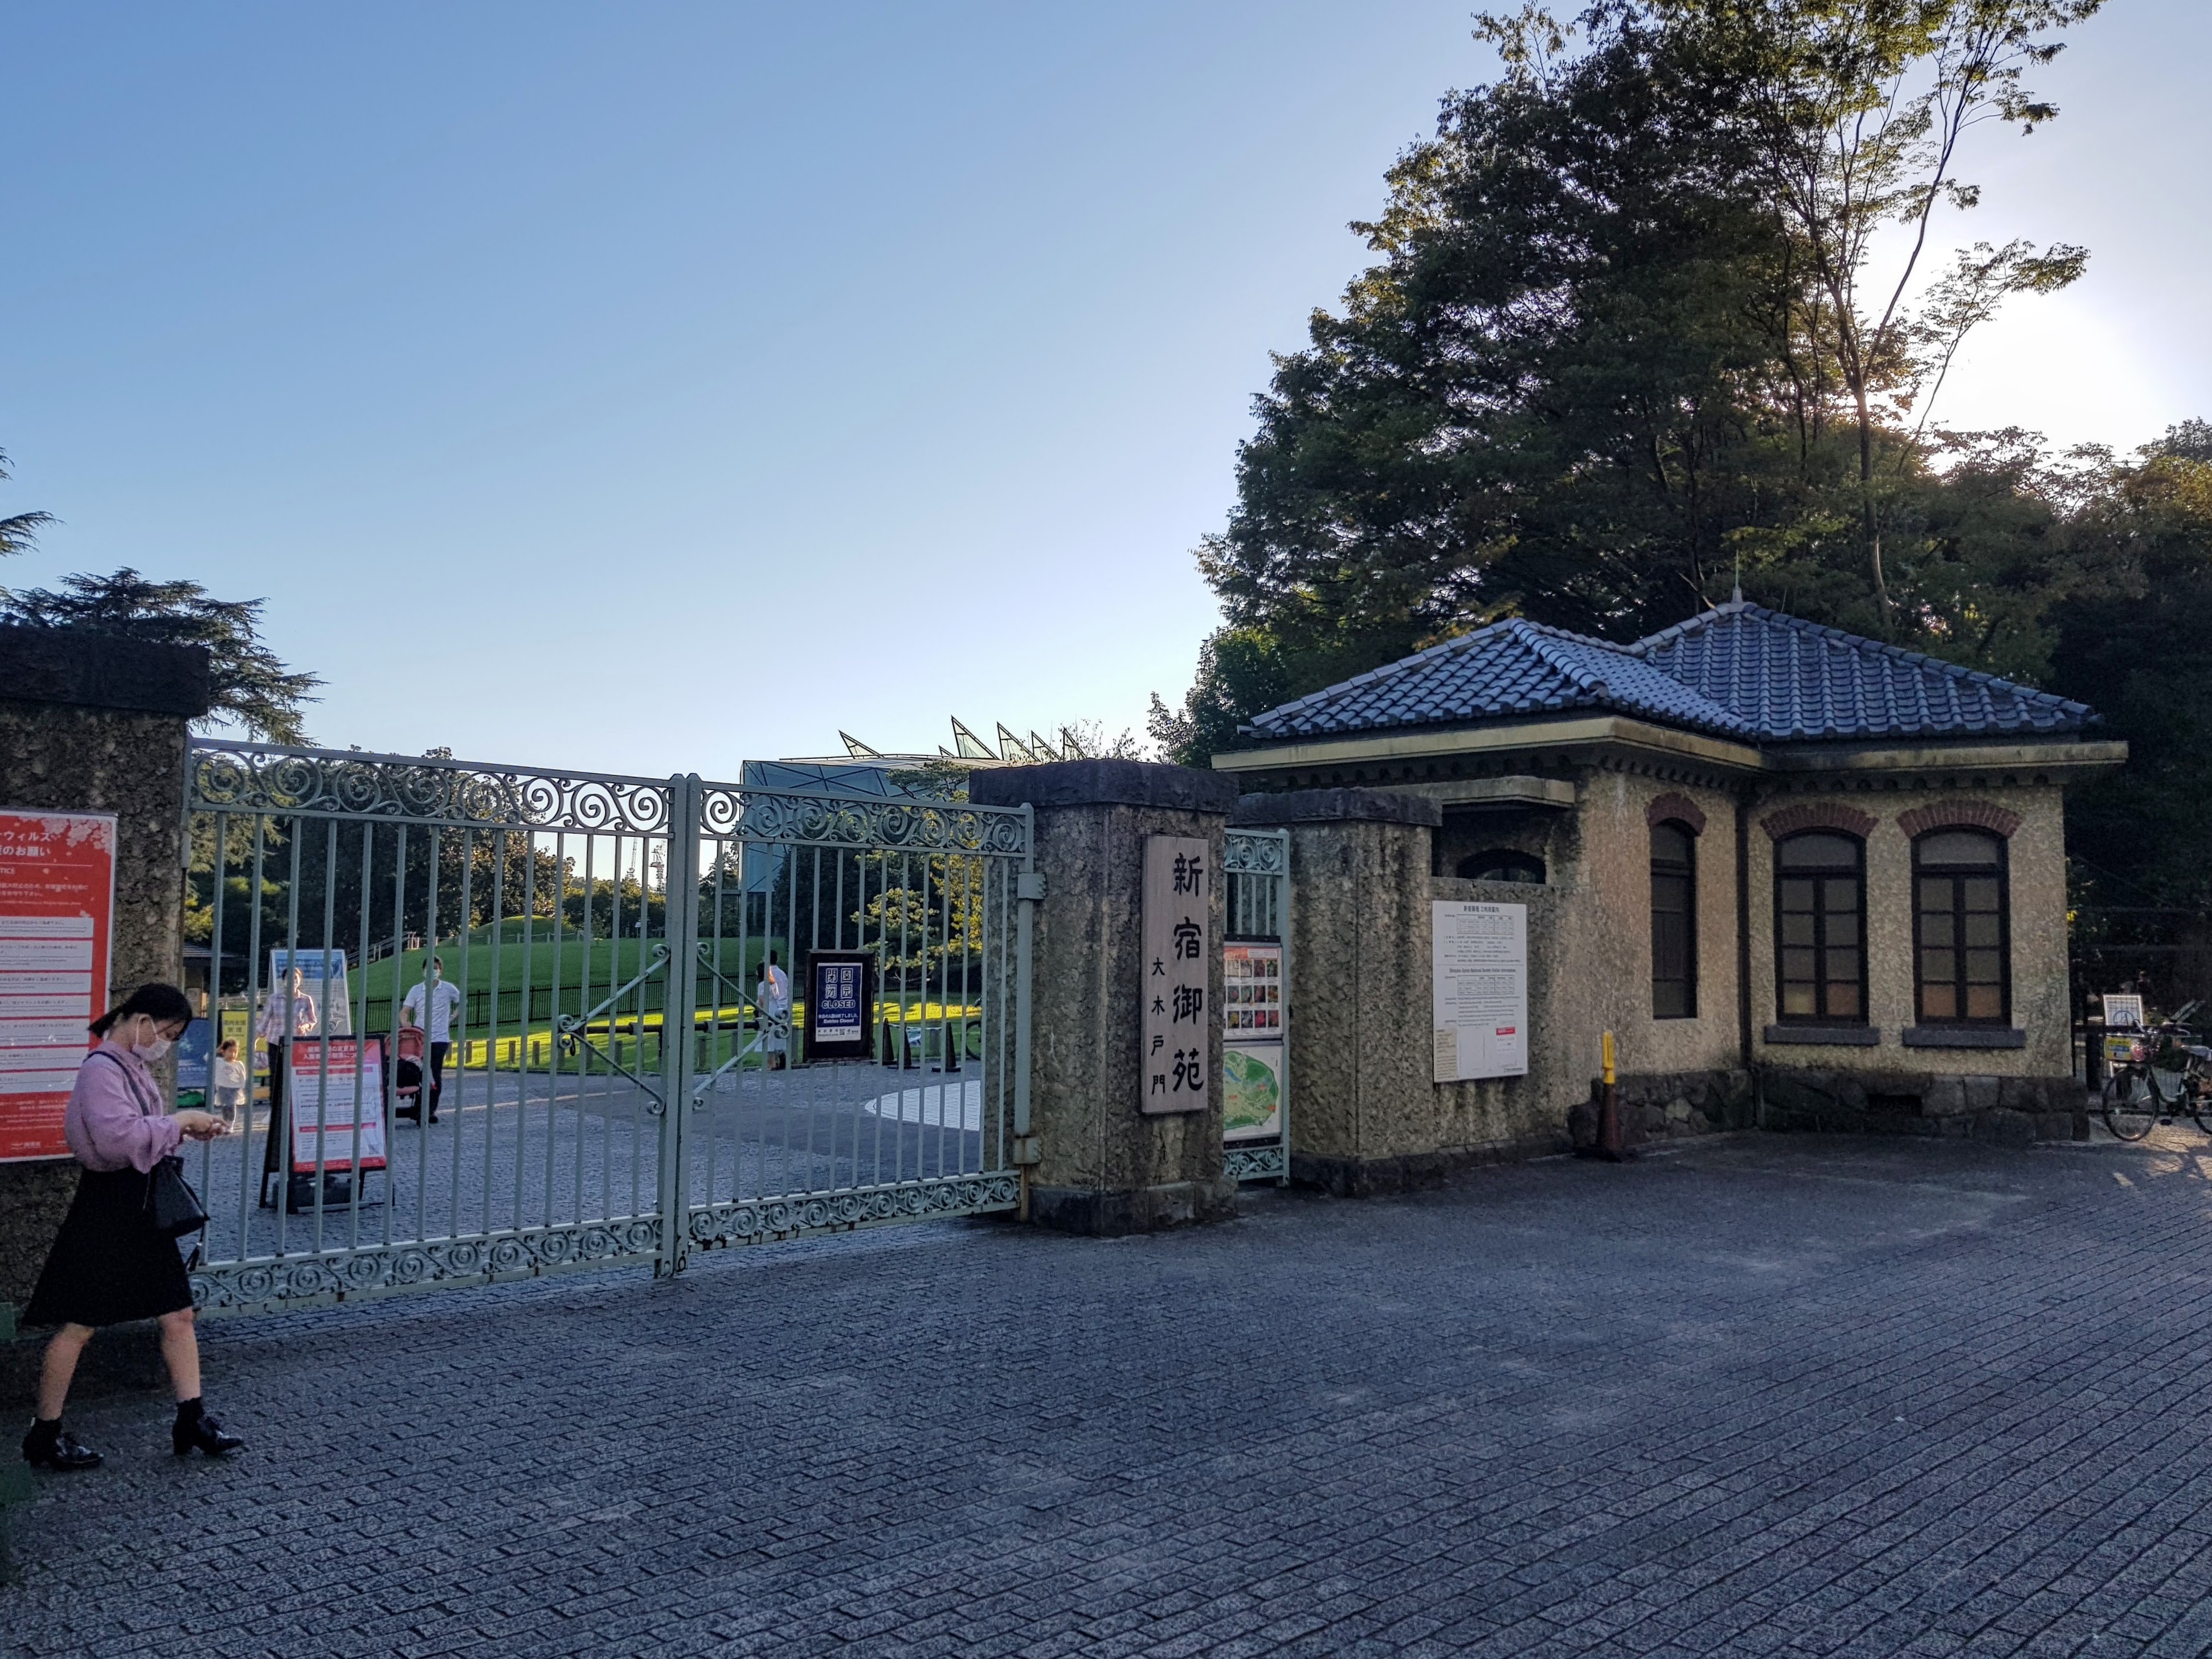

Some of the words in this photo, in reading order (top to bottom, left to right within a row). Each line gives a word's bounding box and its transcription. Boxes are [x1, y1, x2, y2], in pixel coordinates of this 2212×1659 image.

[0, 831, 51, 841] ウィルス
[825, 967, 853, 983] 閉園
[1172, 852, 1204, 1092] 新宿御苑
[825, 984, 853, 999] 闭园
[821, 999, 856, 1009] CLOSED
[1151, 957, 1166, 1096] 大木戸門
